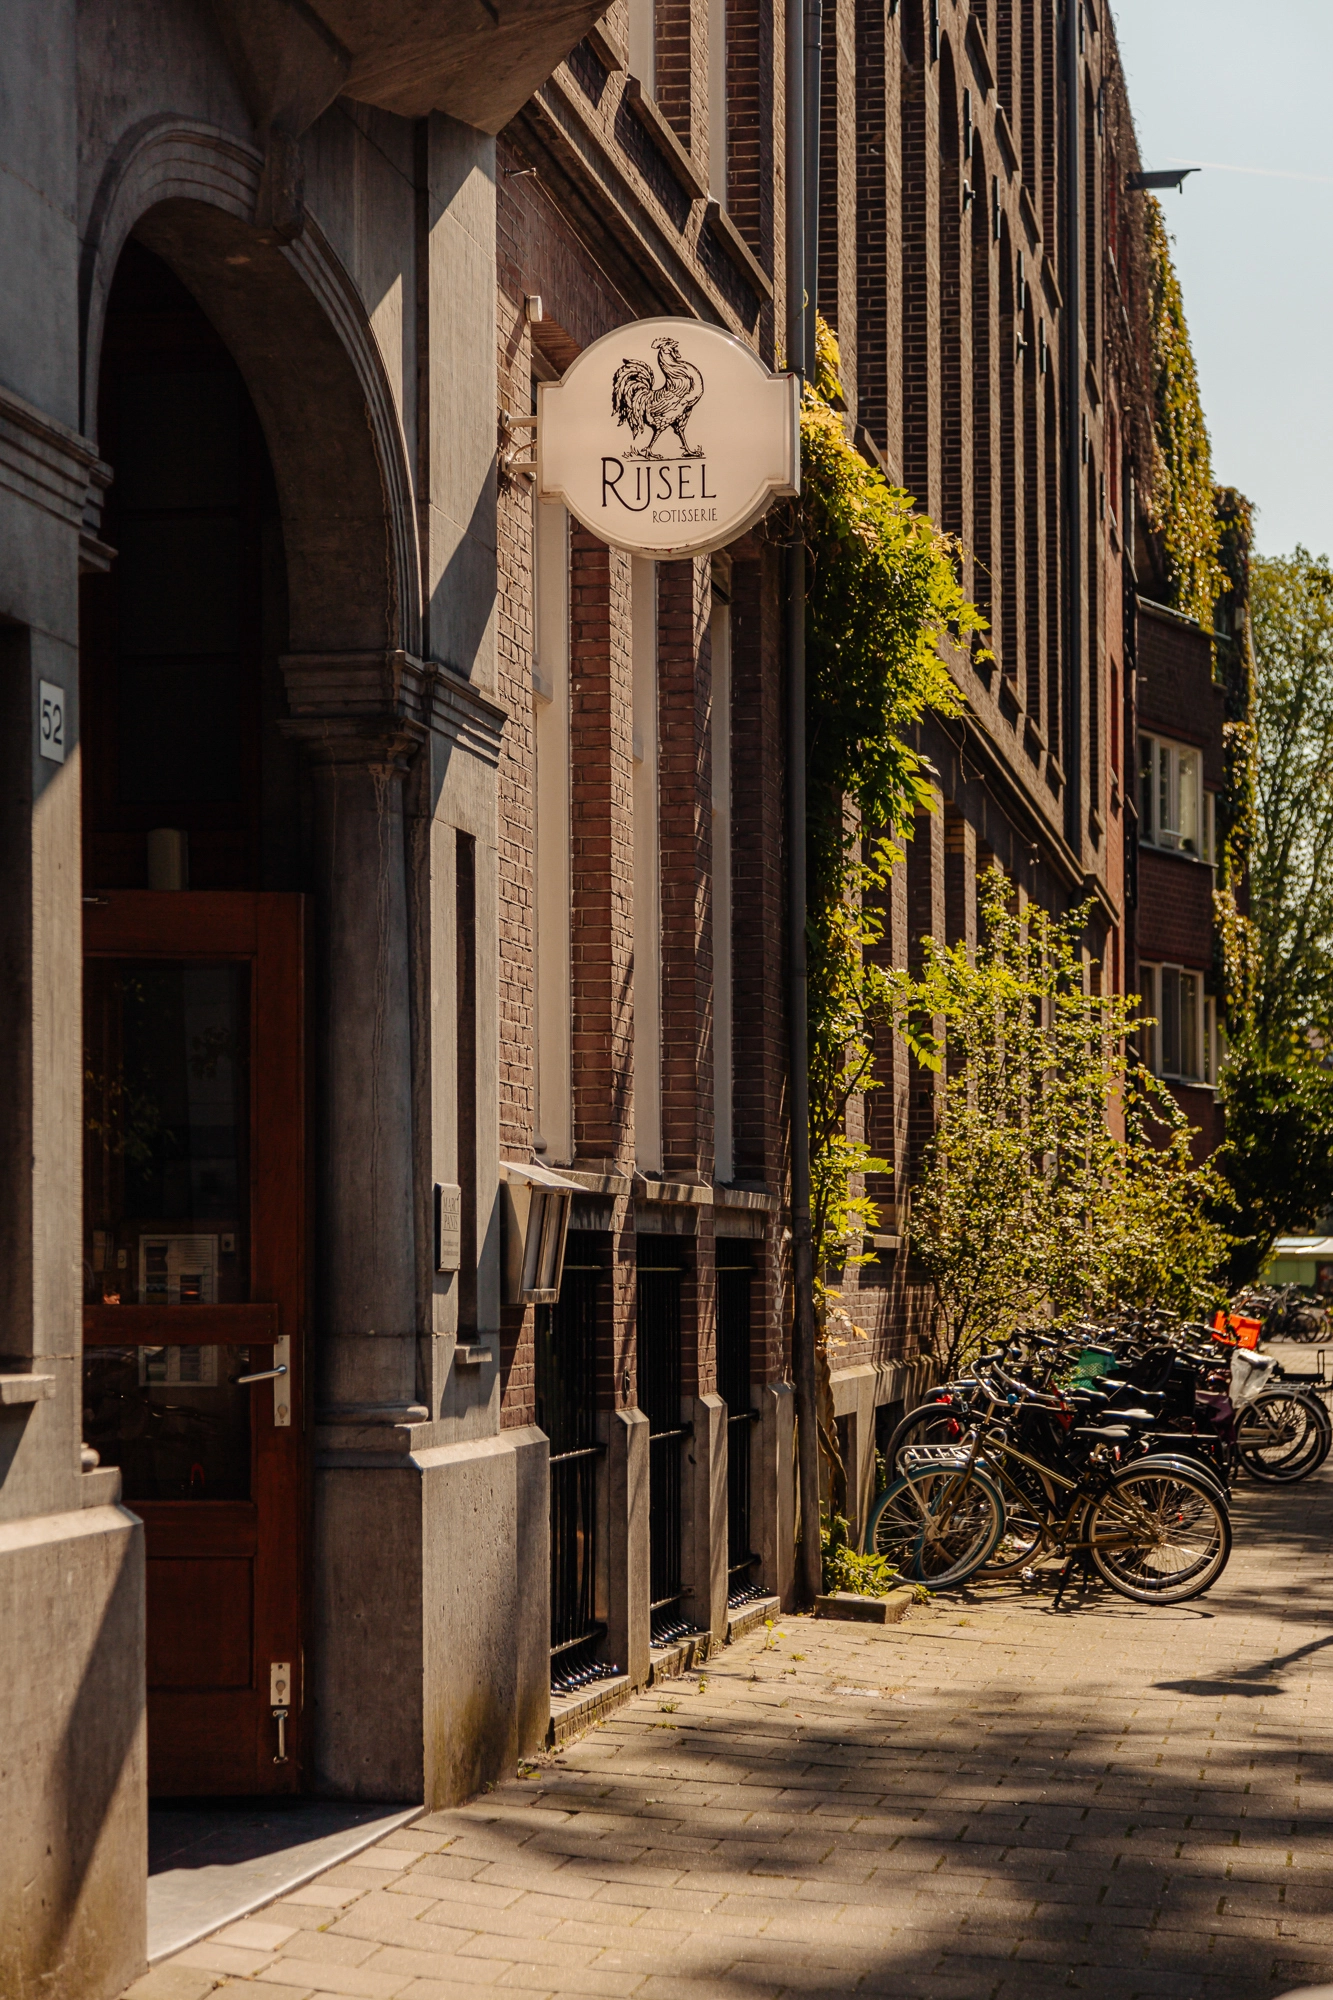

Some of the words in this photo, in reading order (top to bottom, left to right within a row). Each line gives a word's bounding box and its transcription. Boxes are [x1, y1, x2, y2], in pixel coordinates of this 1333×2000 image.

[601, 457, 717, 512] RIJSEL
[652, 508, 718, 523] ROTISSERIE
[42, 698, 62, 745] 52
